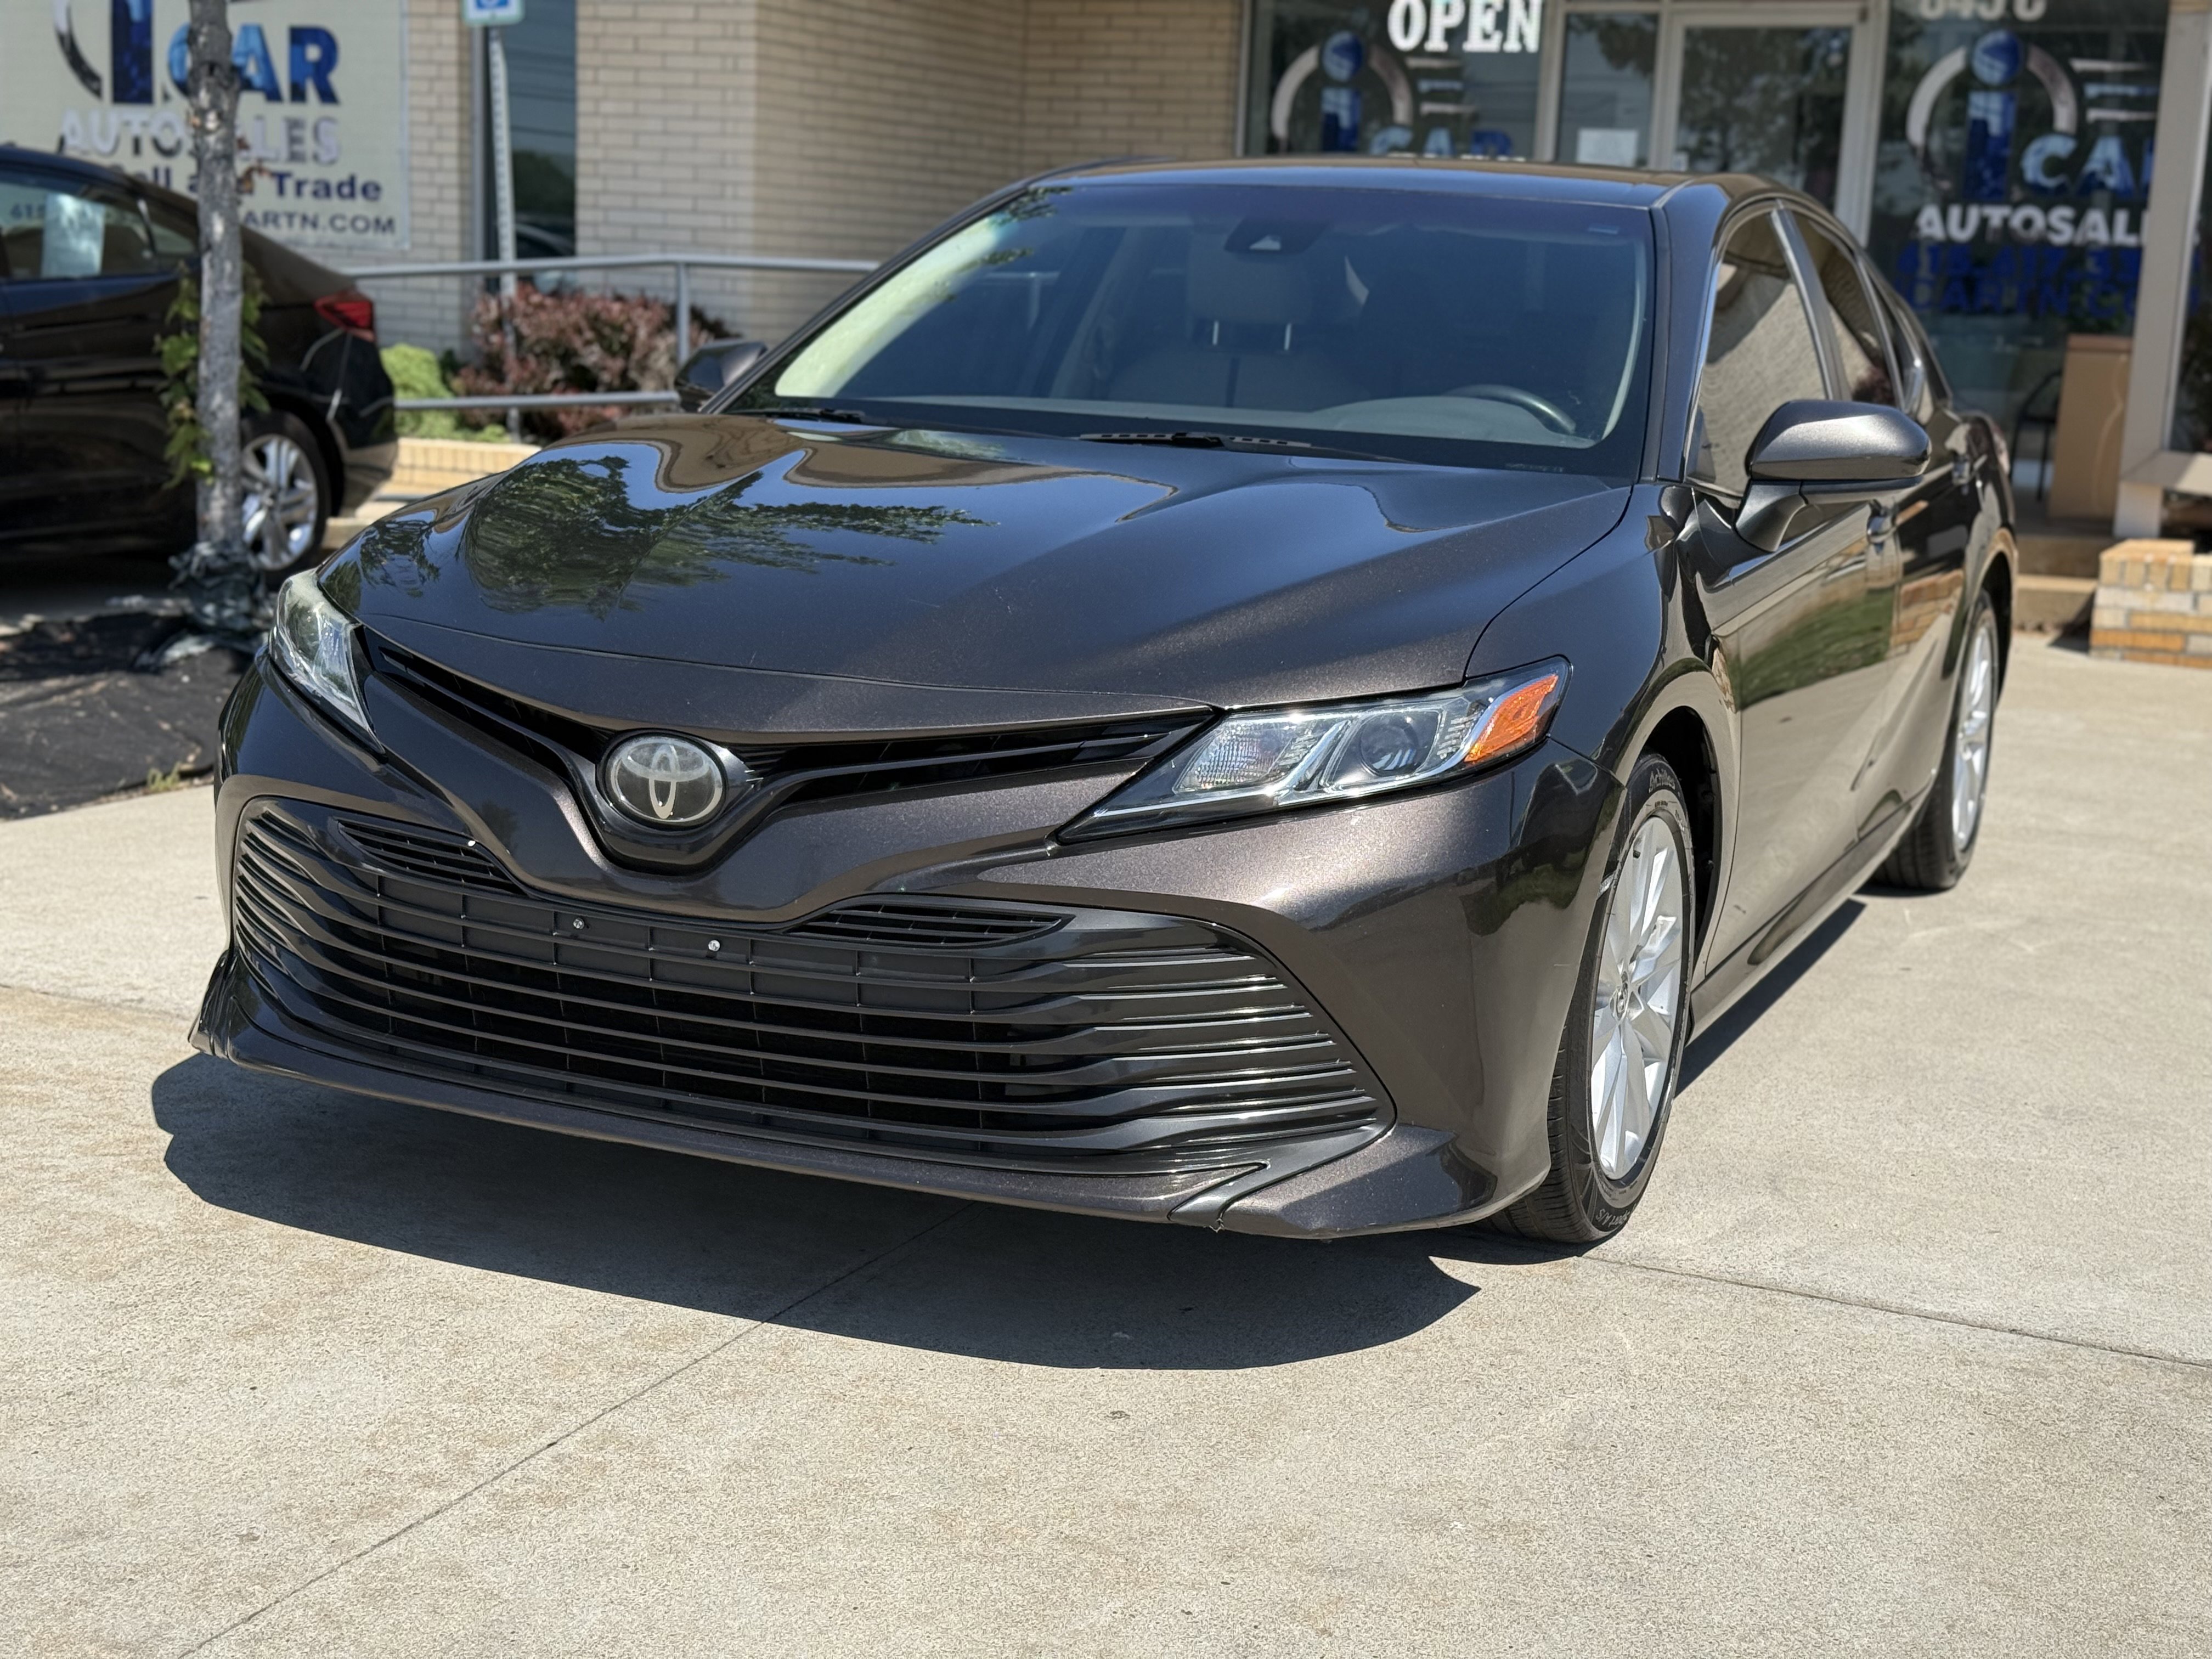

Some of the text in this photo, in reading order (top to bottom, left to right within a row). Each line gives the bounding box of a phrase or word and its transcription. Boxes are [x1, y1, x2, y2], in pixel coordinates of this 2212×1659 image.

[1387, 0, 1541, 53] OPEN
[58, 109, 340, 165] AUTOLES
[272, 171, 381, 201] Trade
